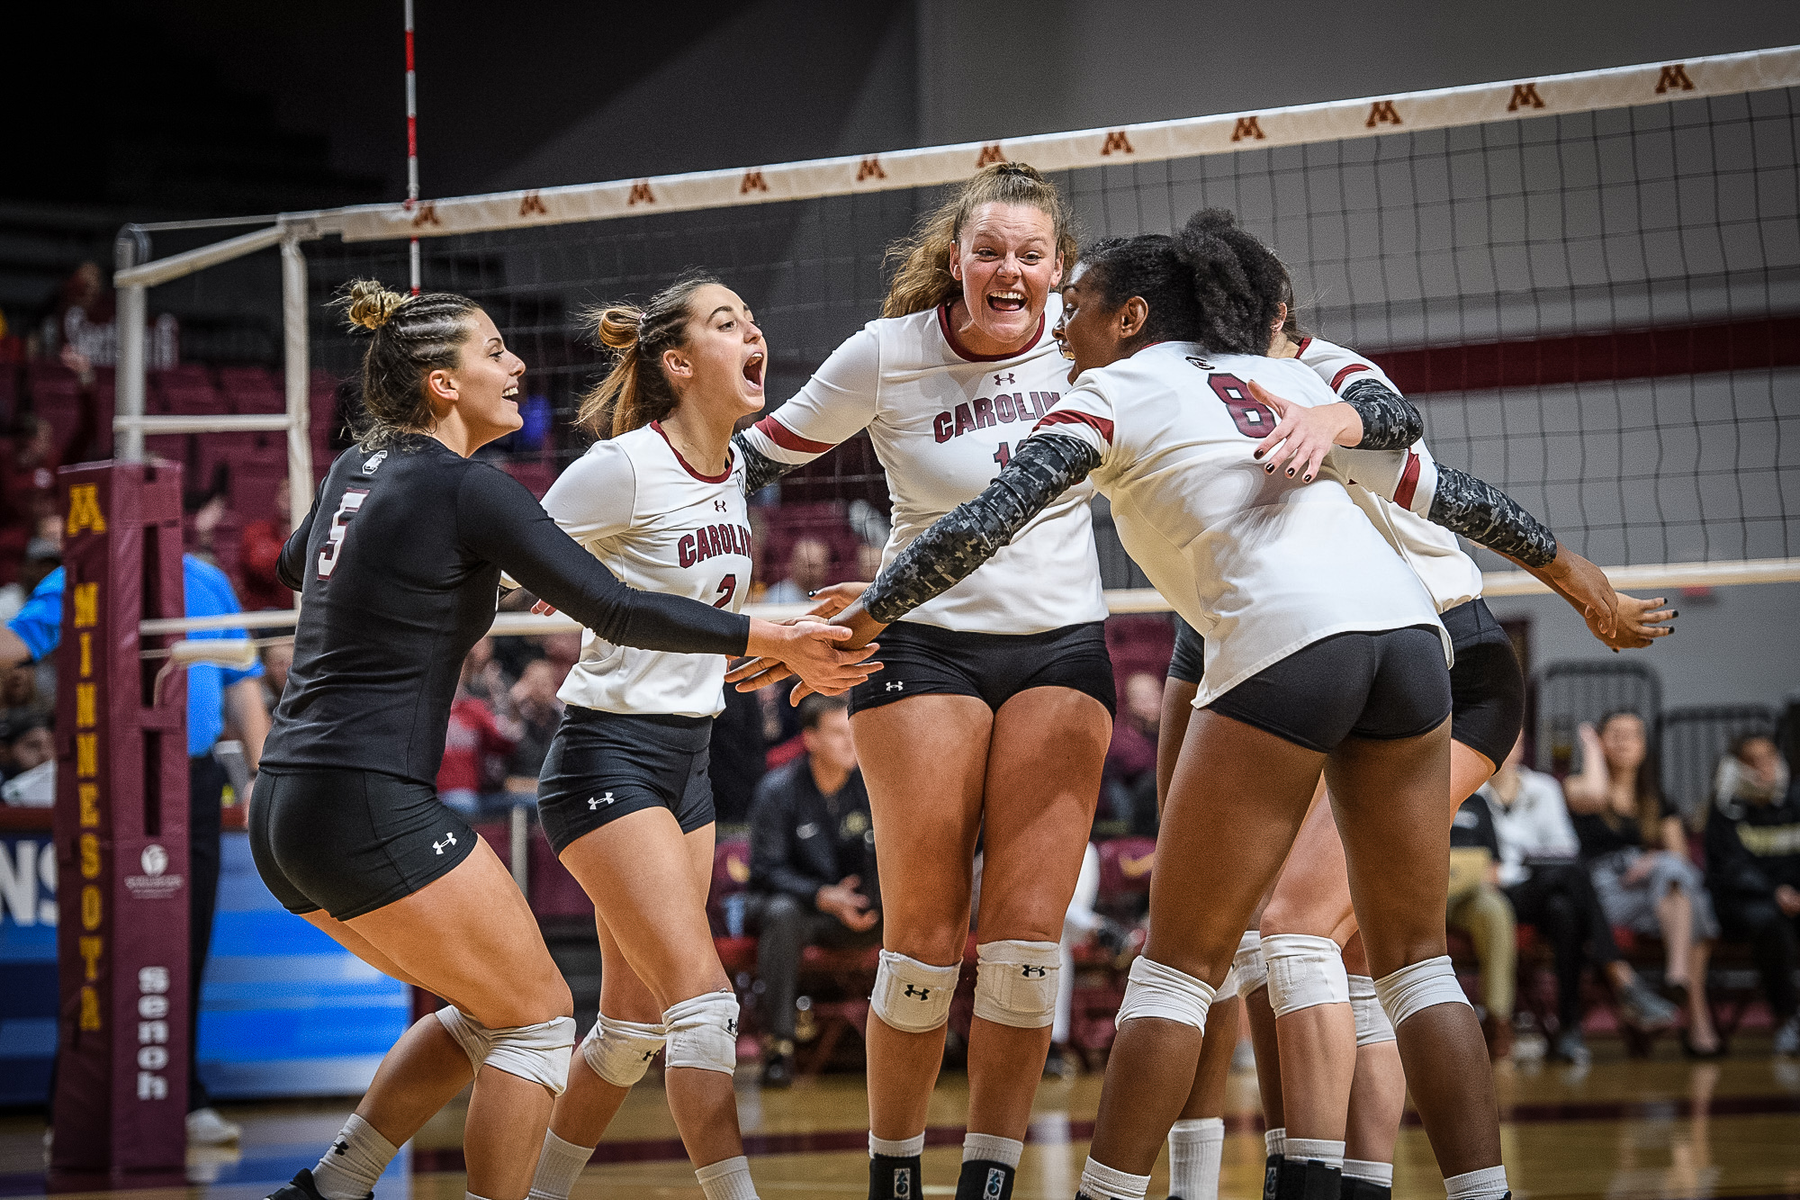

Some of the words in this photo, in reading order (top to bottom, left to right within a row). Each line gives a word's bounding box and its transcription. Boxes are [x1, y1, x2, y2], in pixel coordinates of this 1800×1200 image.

[1655, 64, 1694, 93] M
[1508, 83, 1545, 111] M
[1366, 100, 1401, 127] M
[1101, 131, 1134, 155] M
[1232, 116, 1265, 141] M
[857, 156, 886, 181] M
[1207, 373, 1276, 439] 8
[67, 484, 106, 534] M
[317, 487, 370, 580] 5
[712, 573, 736, 609] 2
[72, 582, 103, 1031] MINNESOTA
